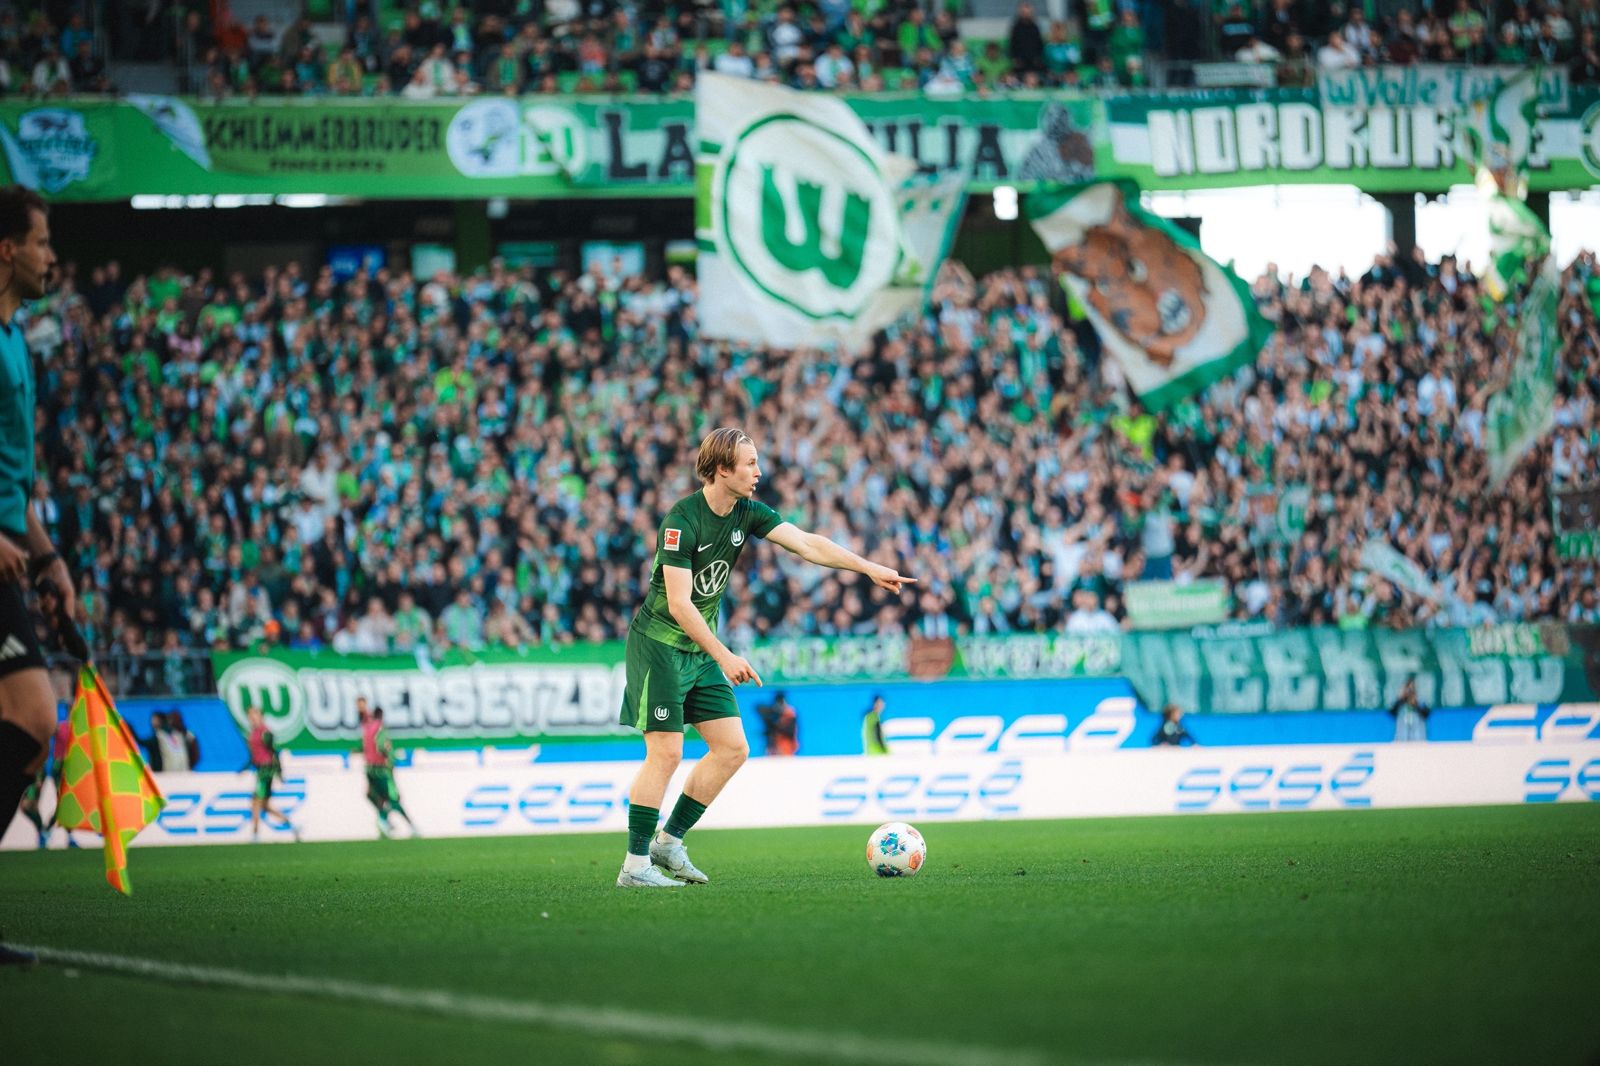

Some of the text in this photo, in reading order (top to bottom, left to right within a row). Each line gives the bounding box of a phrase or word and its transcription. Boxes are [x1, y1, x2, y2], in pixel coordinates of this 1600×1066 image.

[603, 111, 696, 177] LA
[1147, 102, 1550, 177] NORDKUR
[302, 667, 624, 730] UNERSETZB
[463, 782, 631, 827] ses
